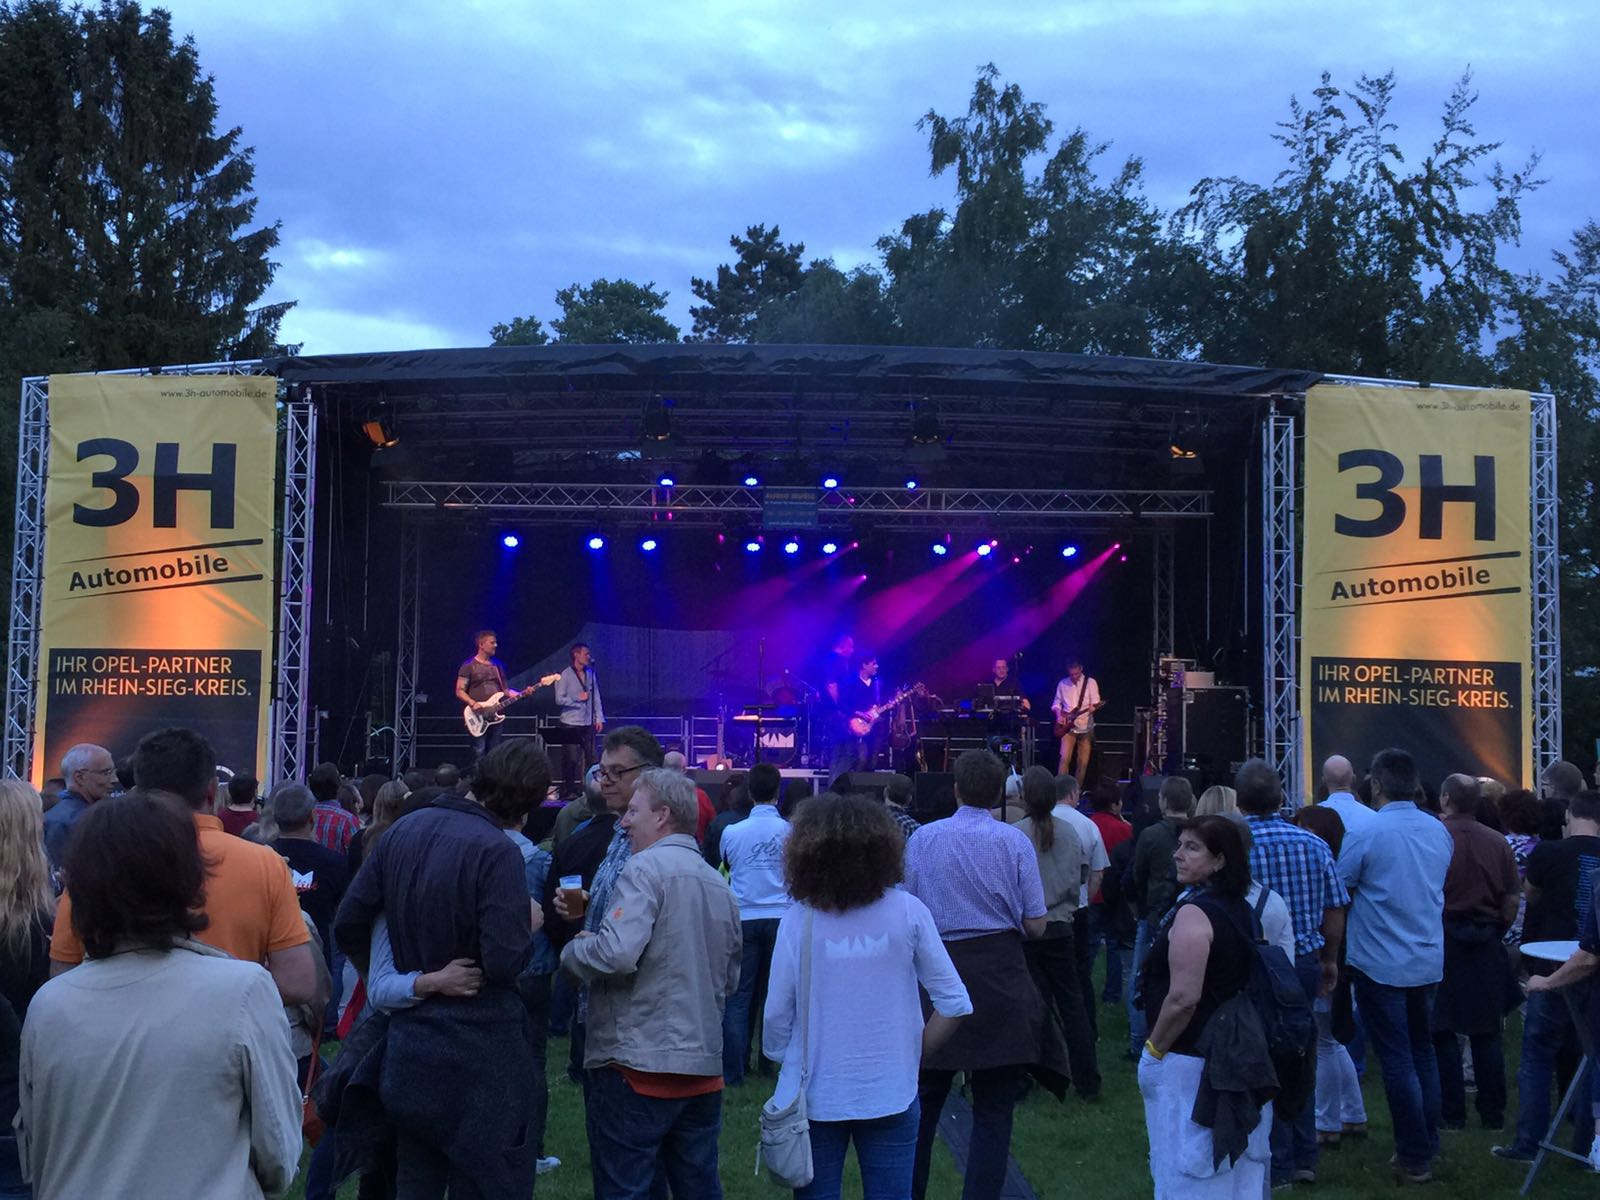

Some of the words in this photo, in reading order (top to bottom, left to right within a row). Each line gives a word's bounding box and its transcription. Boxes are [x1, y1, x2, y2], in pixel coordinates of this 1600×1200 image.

[160, 387, 268, 399] www.3h-automobile.de
[72, 437, 237, 529] 3H
[1334, 448, 1496, 541] 3H
[69, 553, 229, 591] Automobile
[1330, 566, 1490, 601] Automobile
[56, 656, 87, 673] IHR
[92, 656, 232, 675] OPEL-PARTNER
[1319, 664, 1350, 682] IHR
[1354, 665, 1495, 686] OPEL-PARTNER
[55, 678, 77, 695] IM
[81, 678, 252, 697] RHEIN-SIEG-KREIS.
[1318, 686, 1340, 703] IM
[1344, 687, 1514, 708] RHEIN-SIEG-KREIS.
